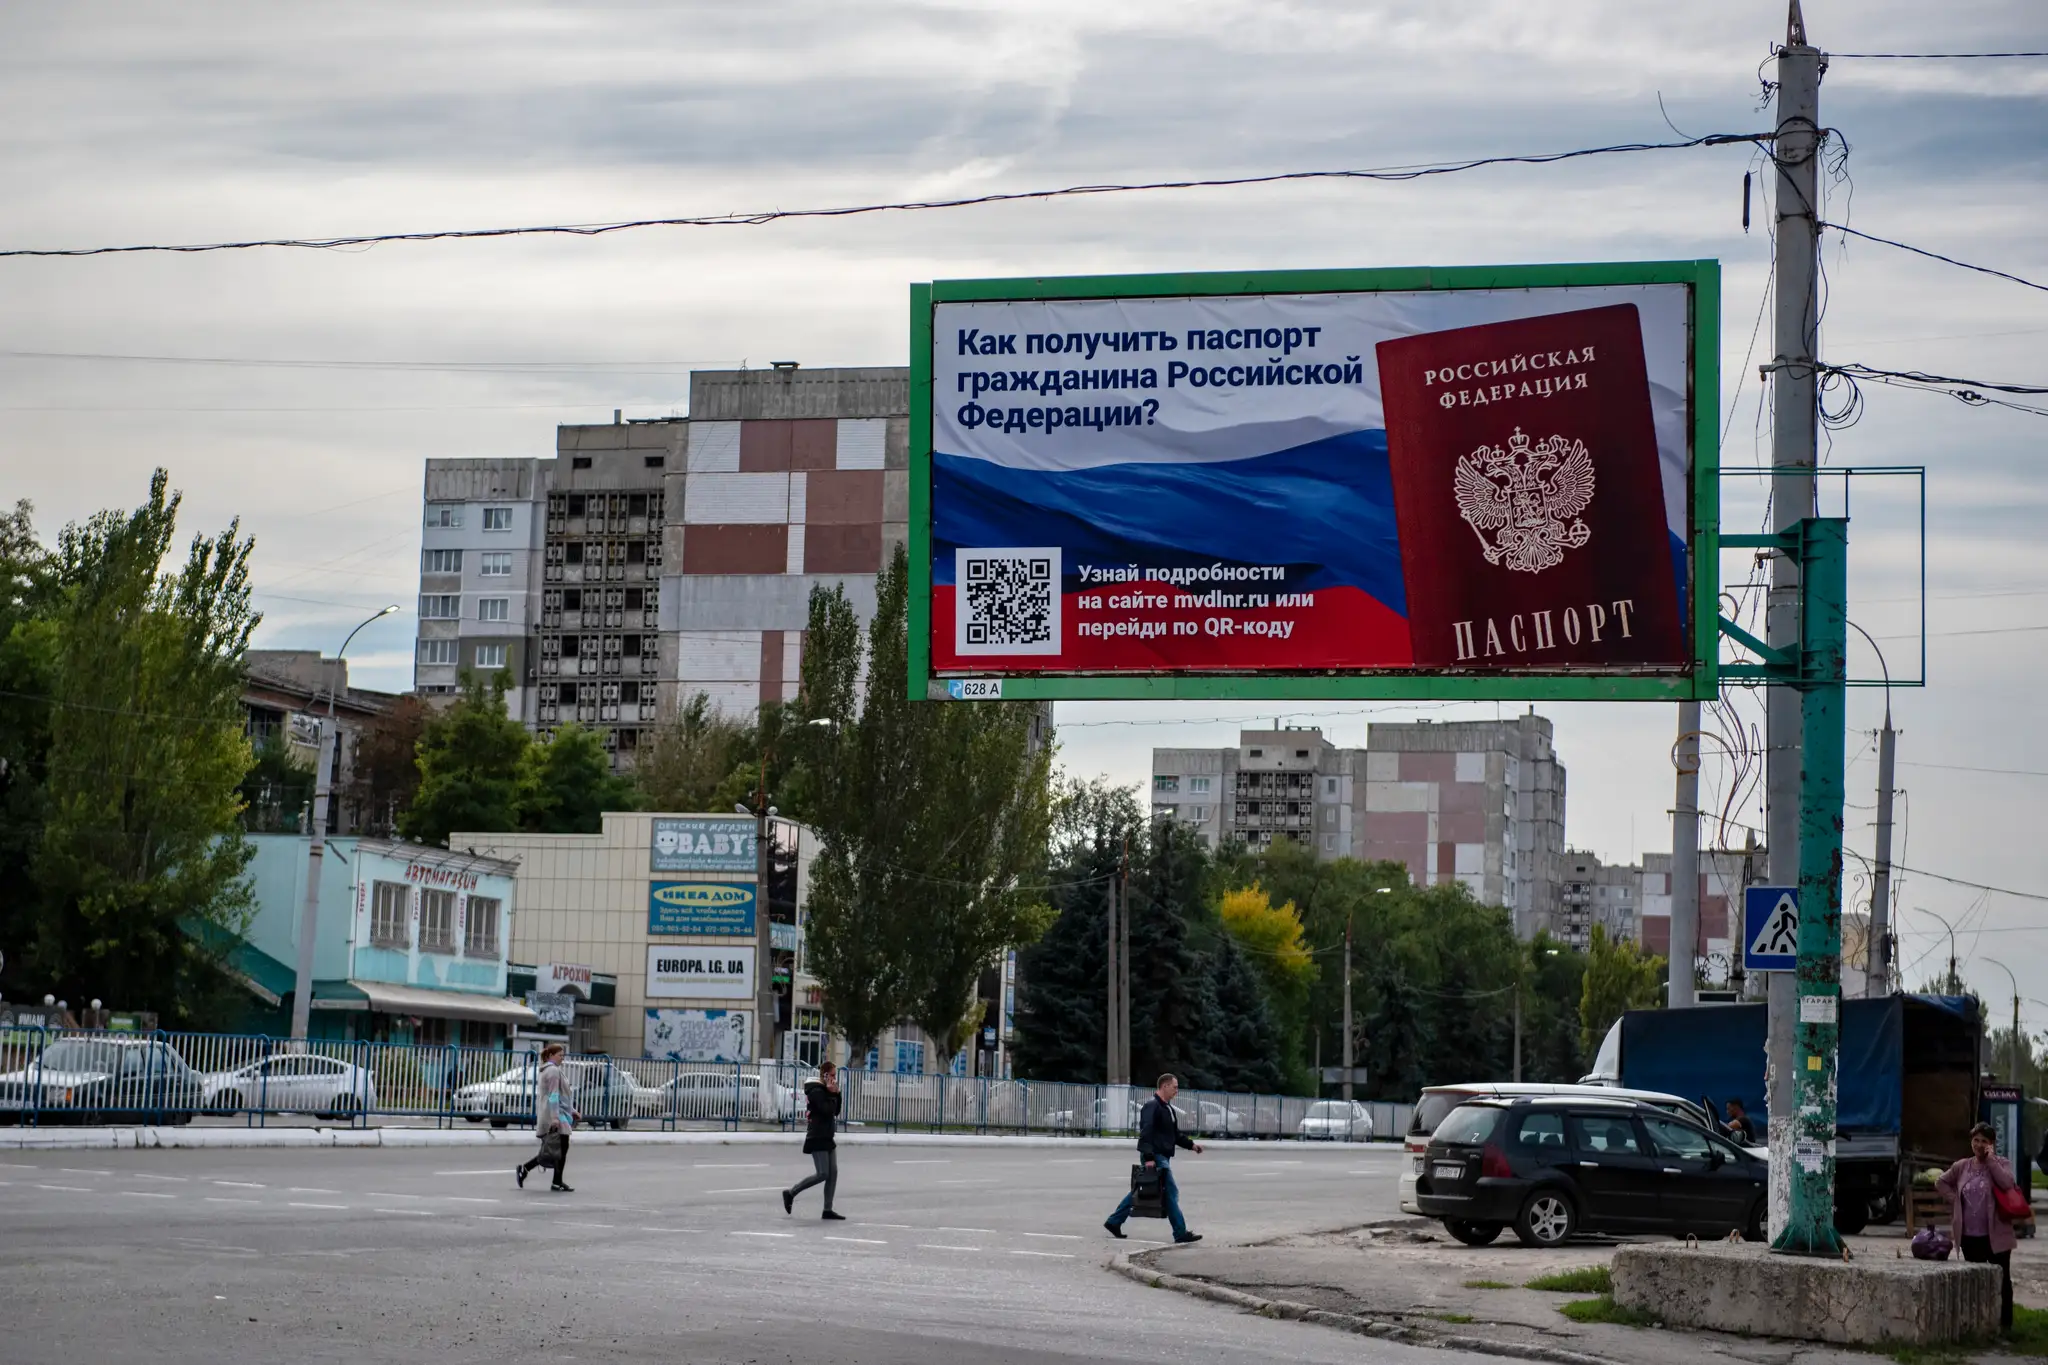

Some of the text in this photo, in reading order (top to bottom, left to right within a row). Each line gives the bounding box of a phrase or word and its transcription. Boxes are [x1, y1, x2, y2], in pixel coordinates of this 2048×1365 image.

[958, 327, 1321, 360] Как получить паспорт
[957, 355, 1362, 399] гражданина Российской
[1424, 346, 1596, 386] РОССИЙСКАЯ
[1439, 373, 1588, 409] ФЕДЕРАЦИЯ
[957, 399, 1159, 435] Федерации?
[1078, 562, 1285, 585] Узнай подробности
[1078, 590, 1314, 609] на сайте mvdlnr.ru или
[1078, 617, 1294, 640] перейди по QR-коду
[1452, 600, 1634, 660] ПАСПОРТ
[964, 683, 999, 695] 628 A
[677, 833, 748, 855] BABY
[404, 864, 478, 891] АВТОМАГАЗИН
[662, 891, 745, 901] ИКЕА ДОМ
[552, 965, 592, 984] АГРОХІМ
[656, 959, 744, 974] EUROPA. LG. UA
[1471, 1132, 1480, 1143] Z
